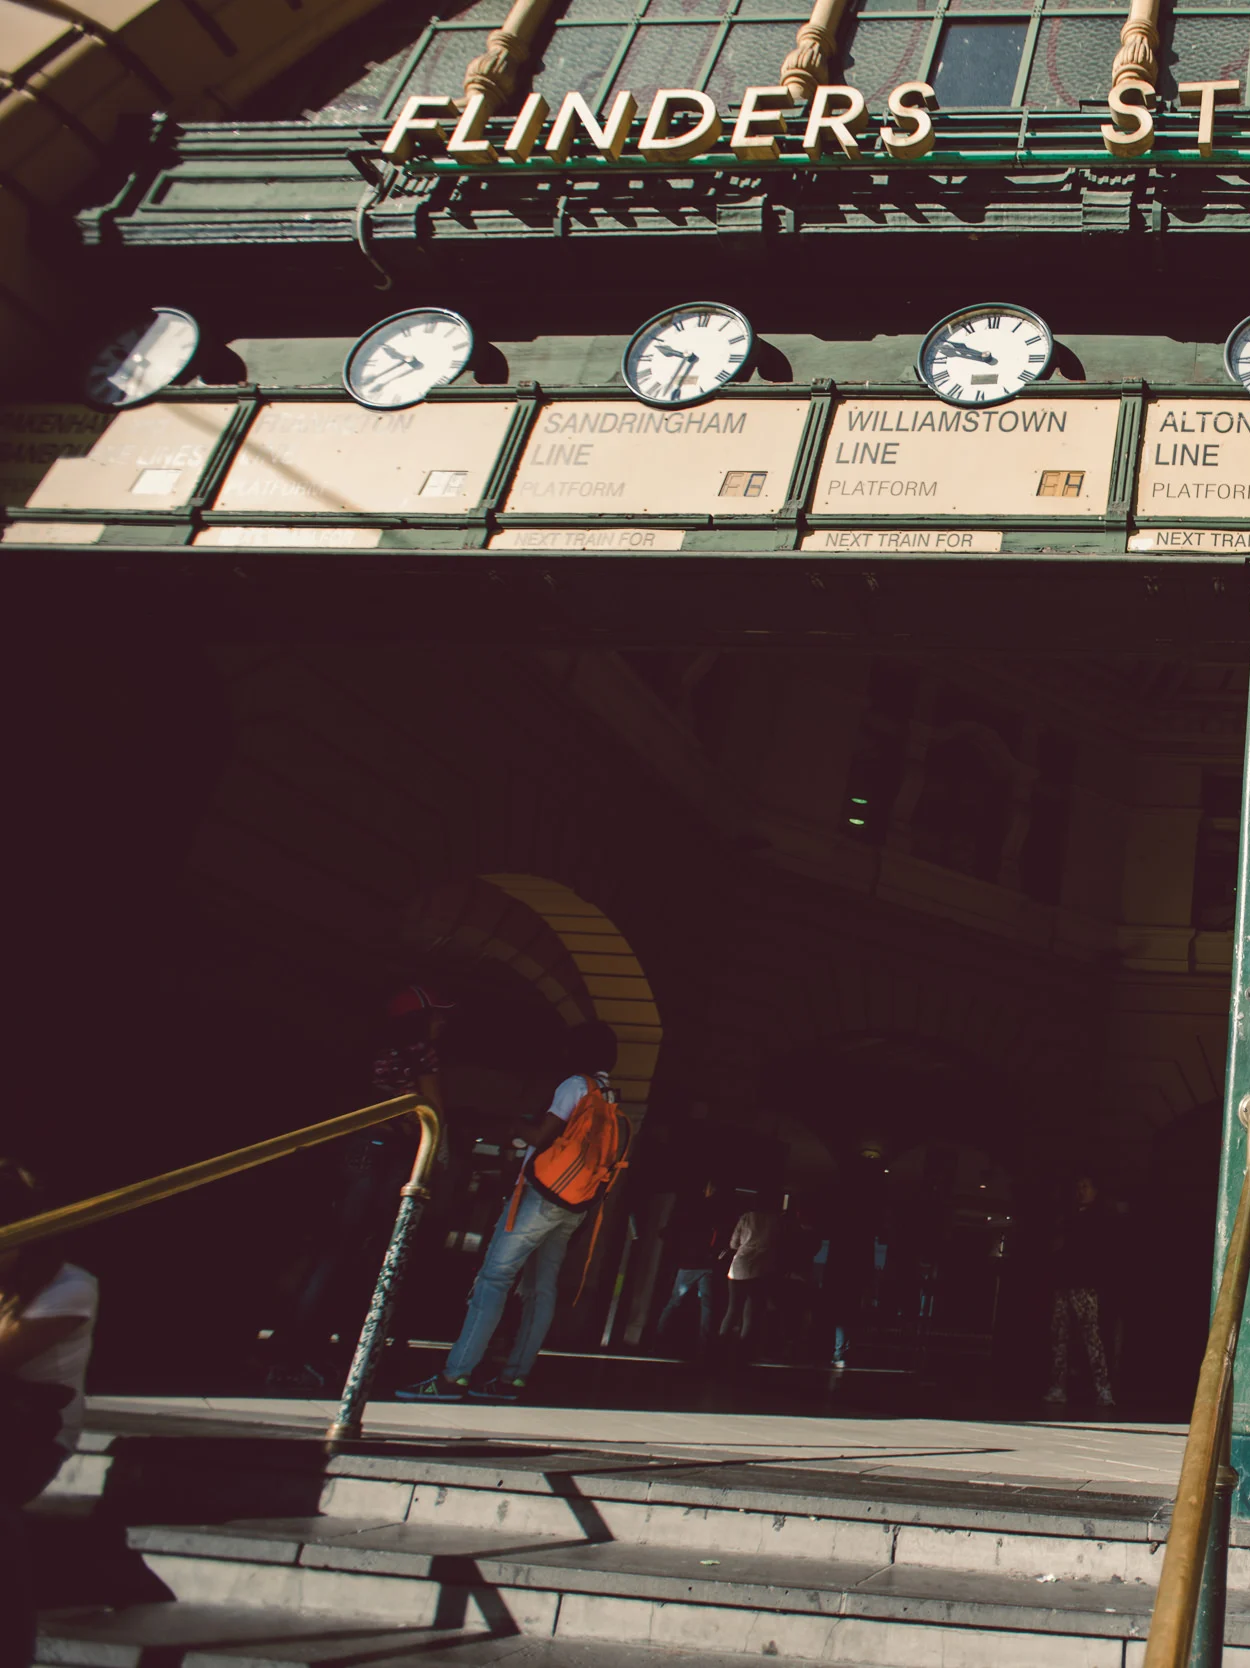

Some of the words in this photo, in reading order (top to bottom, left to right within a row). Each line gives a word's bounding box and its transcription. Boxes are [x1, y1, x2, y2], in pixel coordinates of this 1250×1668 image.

[381, 81, 938, 164] FLINDERS
[544, 412, 747, 434] SANDRINGHAM
[848, 410, 1067, 433] WILLIAMSTOWN
[530, 444, 594, 466] LINE
[835, 442, 900, 464] LINE
[1155, 443, 1220, 467] LINE
[520, 481, 626, 497] PLATFORM
[827, 480, 937, 497] PLATFORM
[514, 532, 560, 546] NEXT
[563, 532, 617, 547] TRAIN
[618, 532, 656, 547] FOR
[825, 533, 873, 547] NEXT
[876, 533, 932, 548] TRAIN
[935, 533, 973, 548] FOR
[1156, 531, 1205, 546] NEXT
